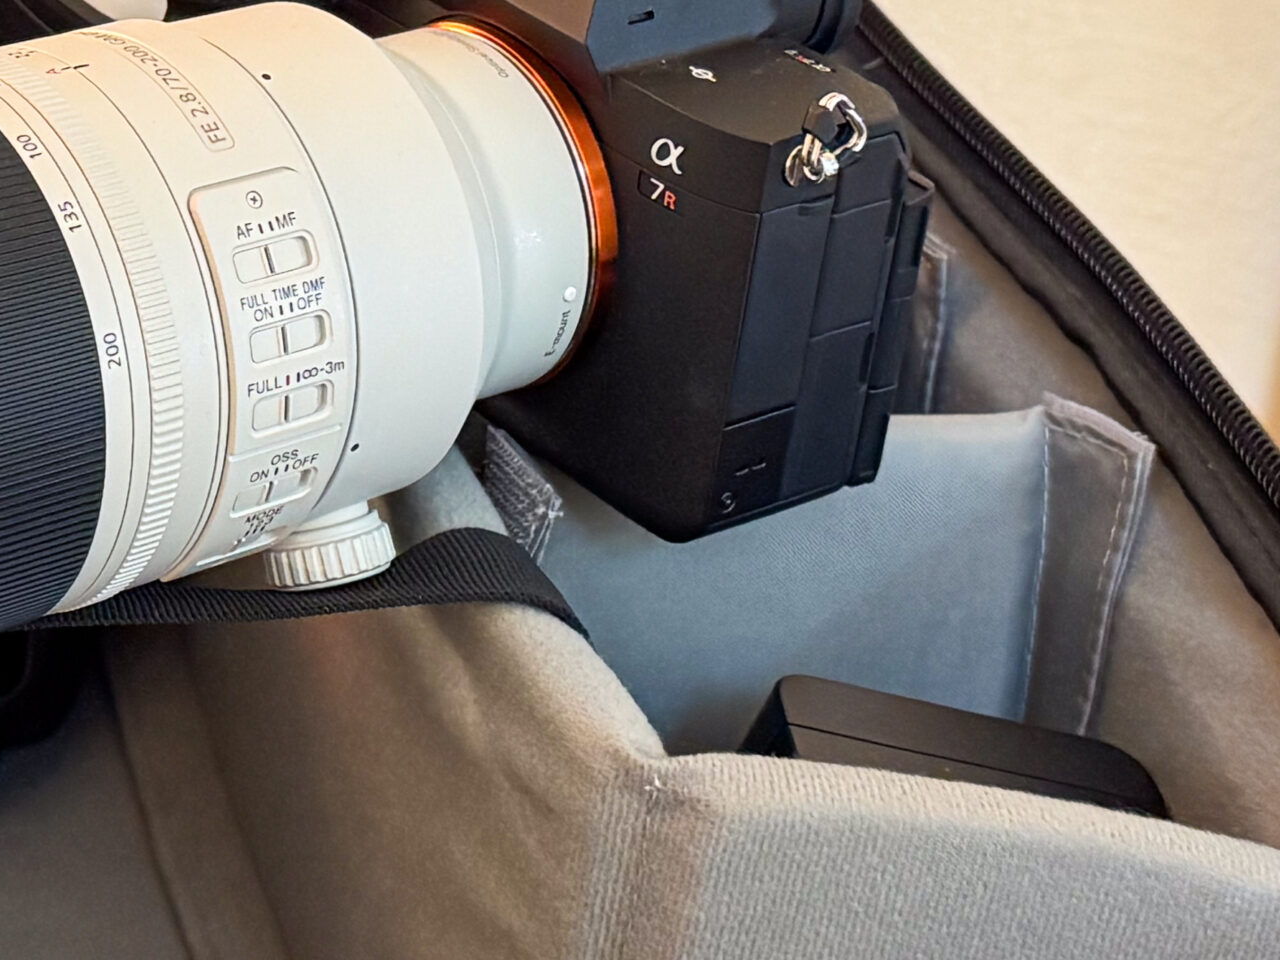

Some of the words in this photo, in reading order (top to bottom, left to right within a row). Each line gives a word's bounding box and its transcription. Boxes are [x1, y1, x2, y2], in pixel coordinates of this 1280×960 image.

[123, 45, 210, 118] 2.8/70-200
[16, 133, 43, 159] 100
[201, 121, 226, 145] FE
[650, 137, 685, 175] α
[650, 177, 677, 210] 7R
[58, 200, 82, 233] 135
[237, 222, 254, 240] AF
[274, 211, 297, 230] MF
[240, 293, 269, 311] FULL
[272, 284, 299, 301] TIME
[302, 276, 326, 295] DMF
[253, 306, 274, 322] ON
[297, 292, 323, 310] OFF
[103, 332, 122, 369] 200
[247, 376, 283, 398] FULL
[249, 469, 270, 483] ON
[292, 452, 320, 470] OFF
[271, 449, 299, 466] OSS
